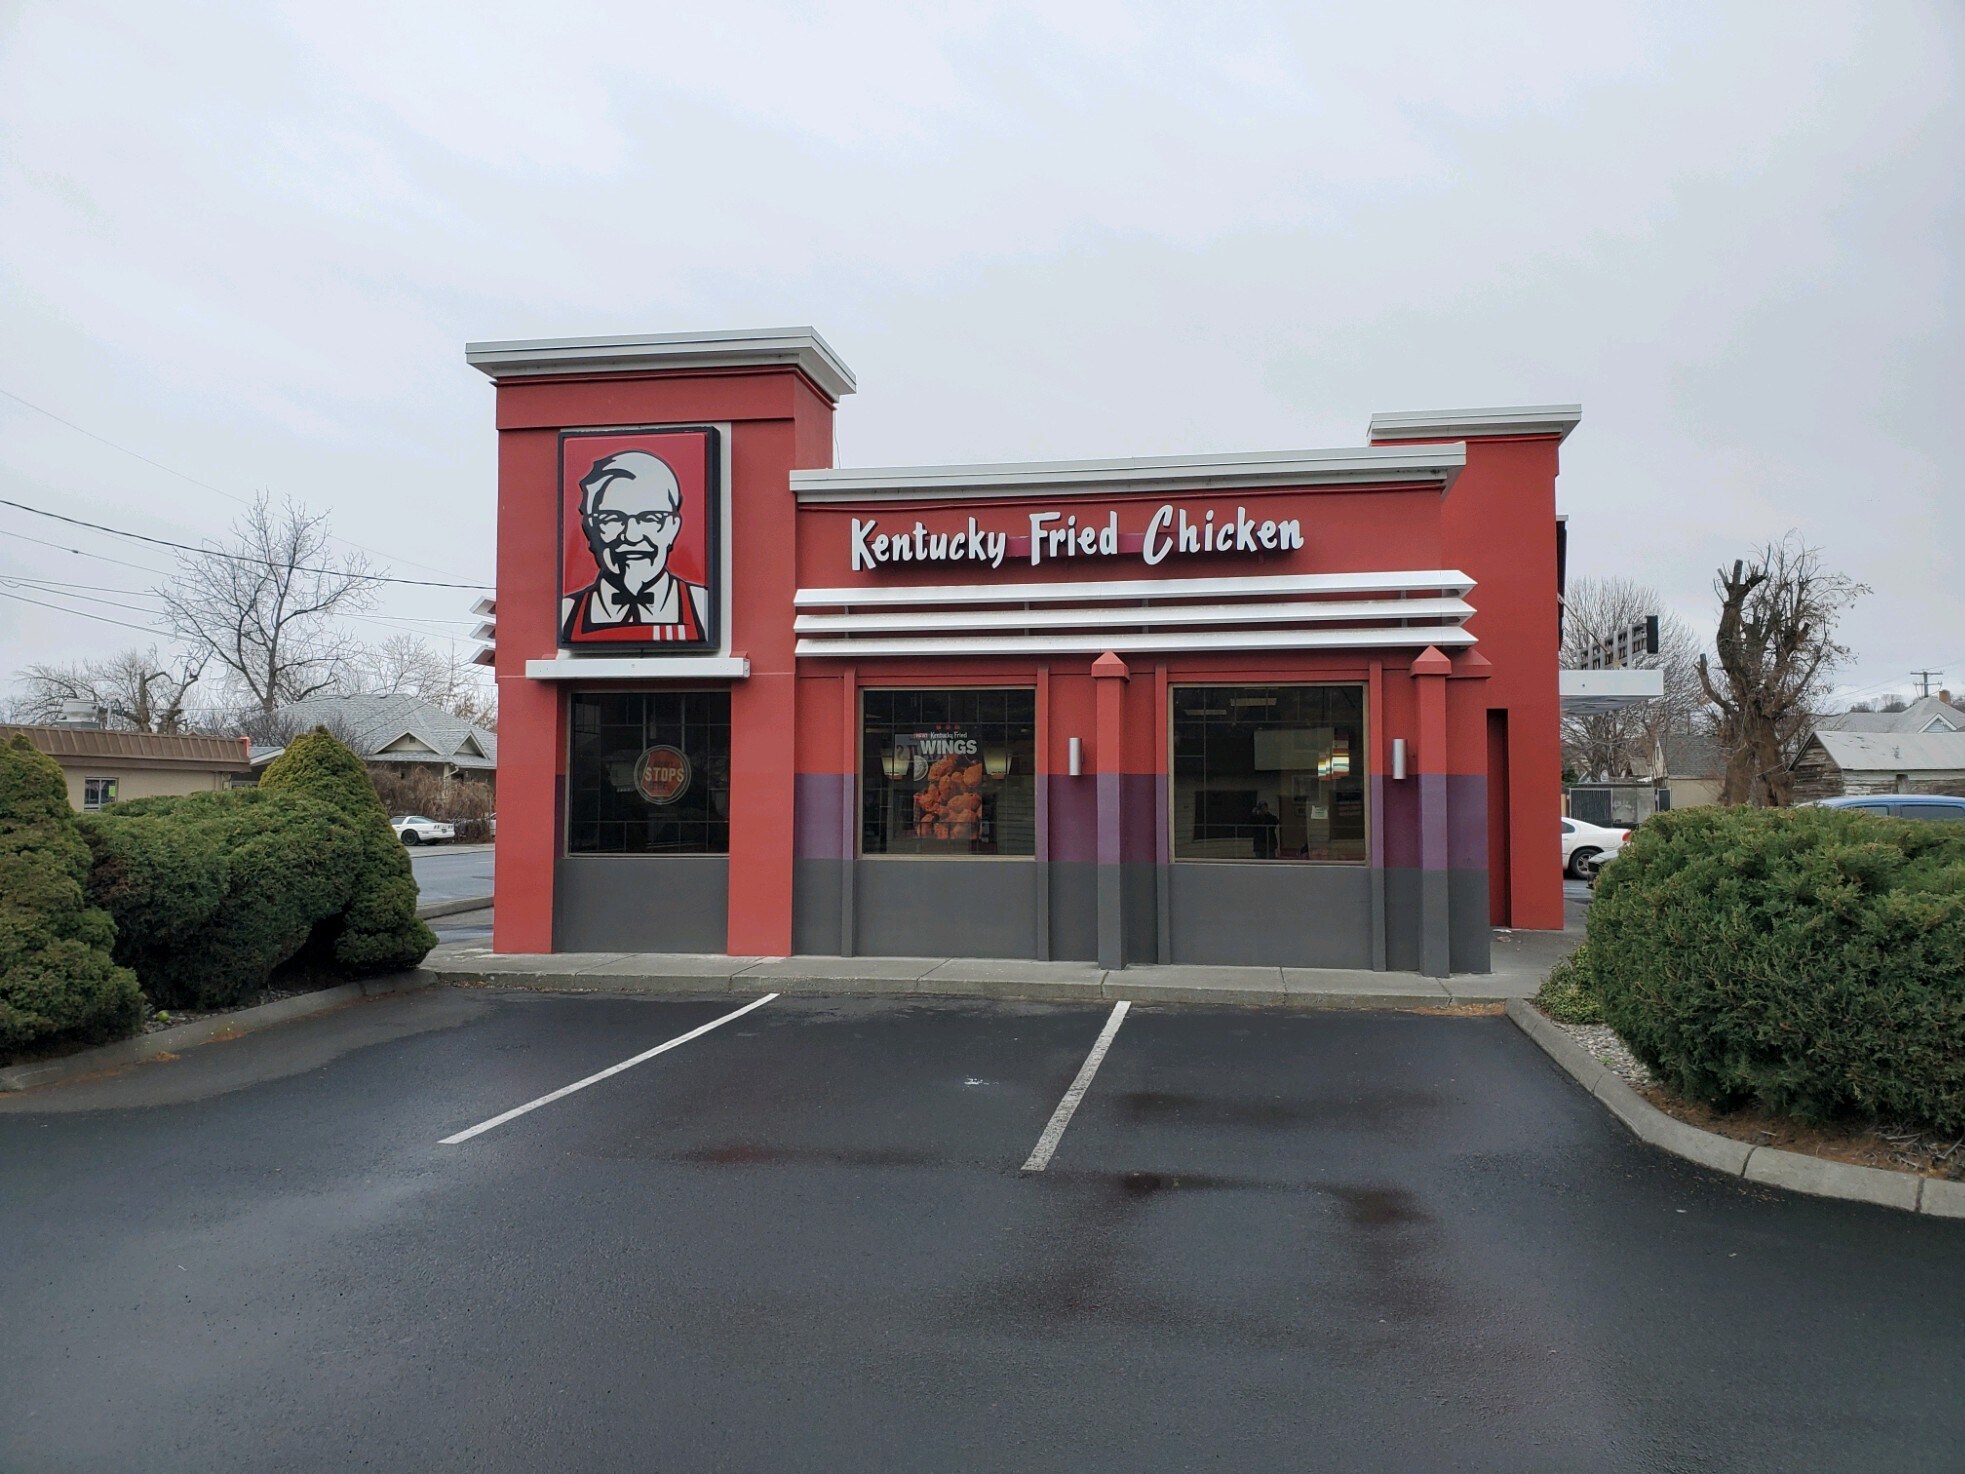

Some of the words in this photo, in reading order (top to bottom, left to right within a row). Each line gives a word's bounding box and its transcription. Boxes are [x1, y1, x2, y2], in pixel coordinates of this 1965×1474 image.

[851, 517, 1006, 571] Kentucky
[1029, 511, 1118, 566] Fried
[1142, 504, 1304, 565] Chicken
[920, 739, 978, 755] WINGS
[644, 767, 685, 783] STOPS
